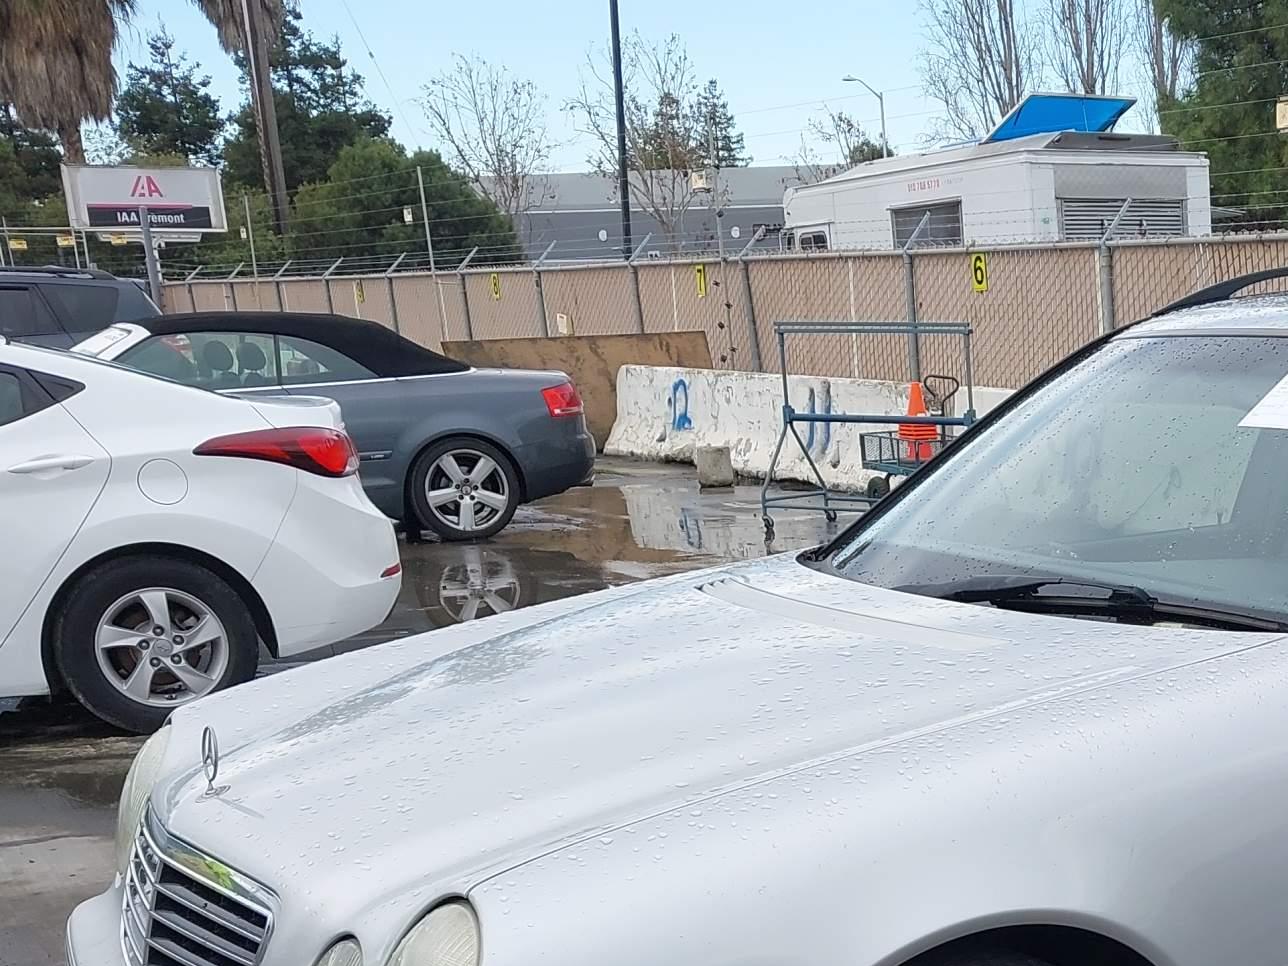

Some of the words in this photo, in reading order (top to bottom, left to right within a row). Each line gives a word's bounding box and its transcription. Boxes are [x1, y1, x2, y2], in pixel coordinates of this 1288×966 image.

[116, 211, 139, 223] IAA
[146, 212, 185, 224] remont
[973, 255, 984, 286] 6
